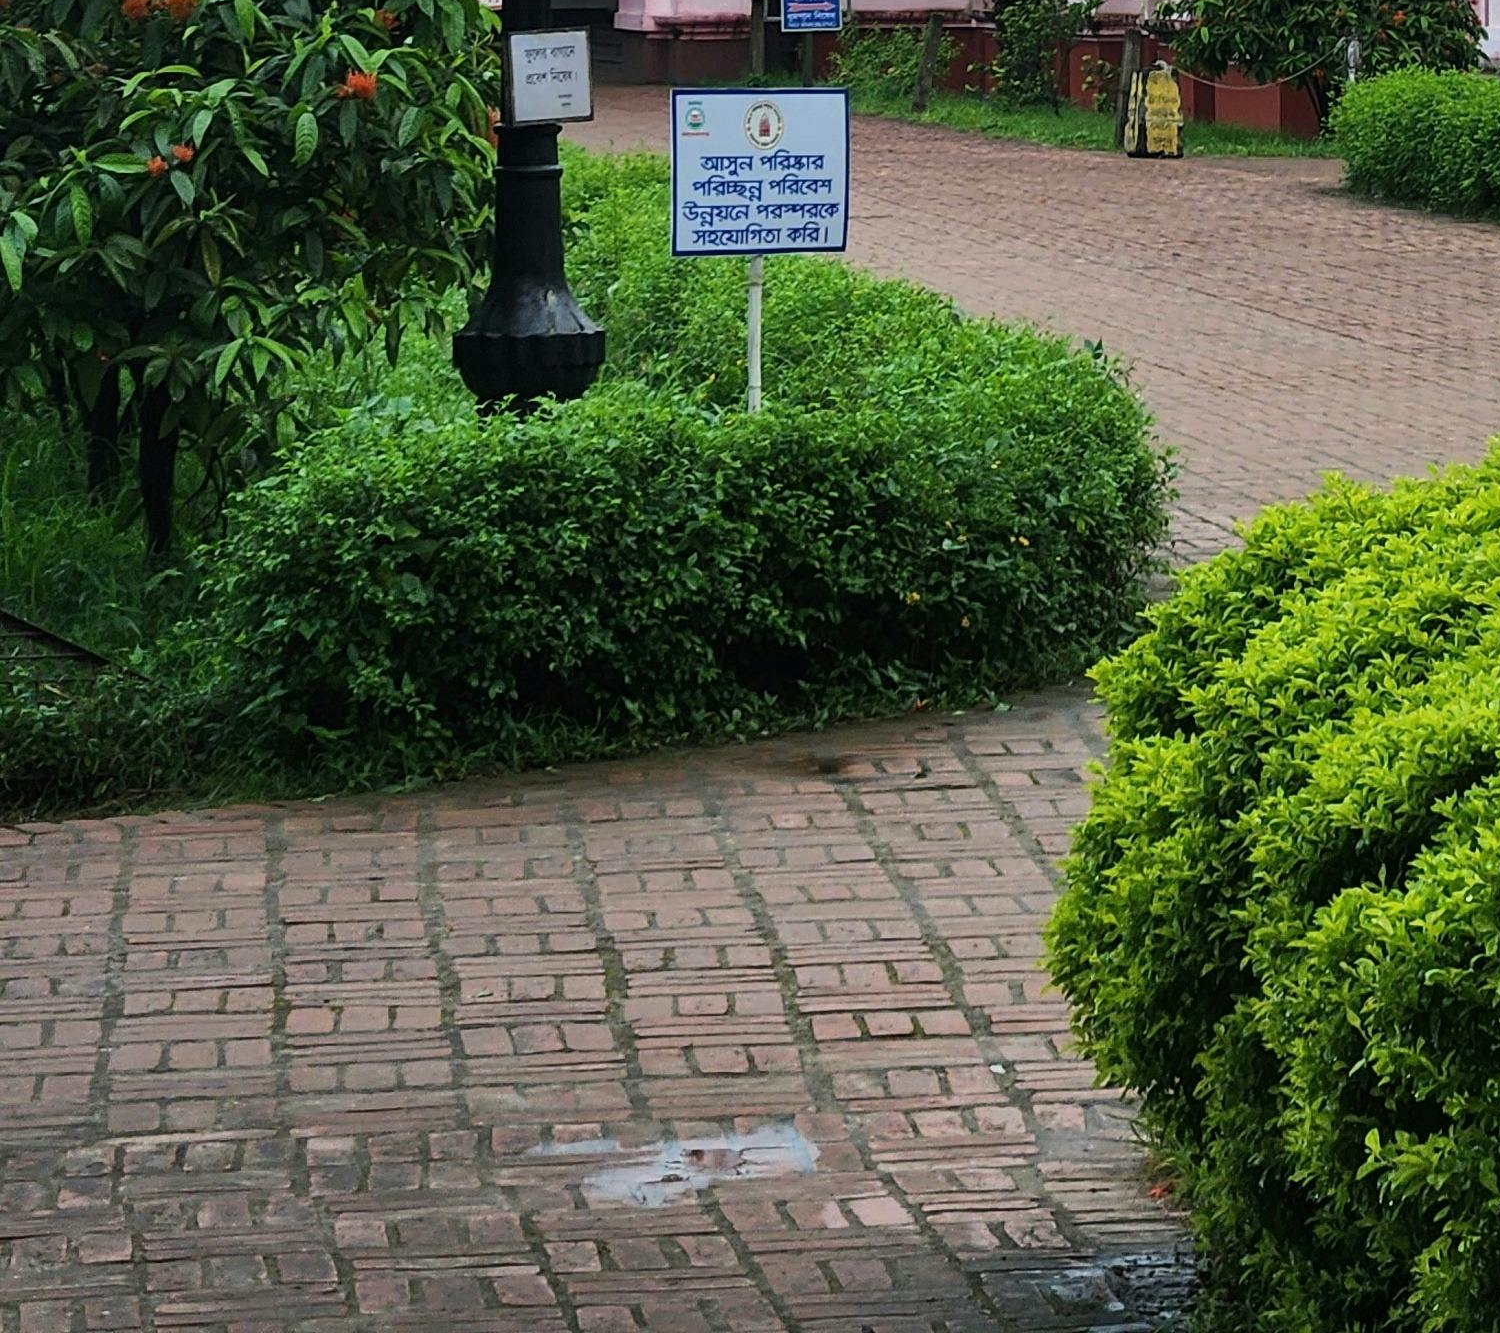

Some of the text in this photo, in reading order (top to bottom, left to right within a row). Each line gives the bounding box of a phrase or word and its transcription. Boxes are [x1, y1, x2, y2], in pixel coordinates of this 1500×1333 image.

[700, 154, 753, 177] আসুন
[692, 173, 832, 202] পরিচ্ছন্ন পরিবেশ
[757, 202, 840, 220] পরস্পরকে
[692, 222, 782, 246] সহযোগিতা
